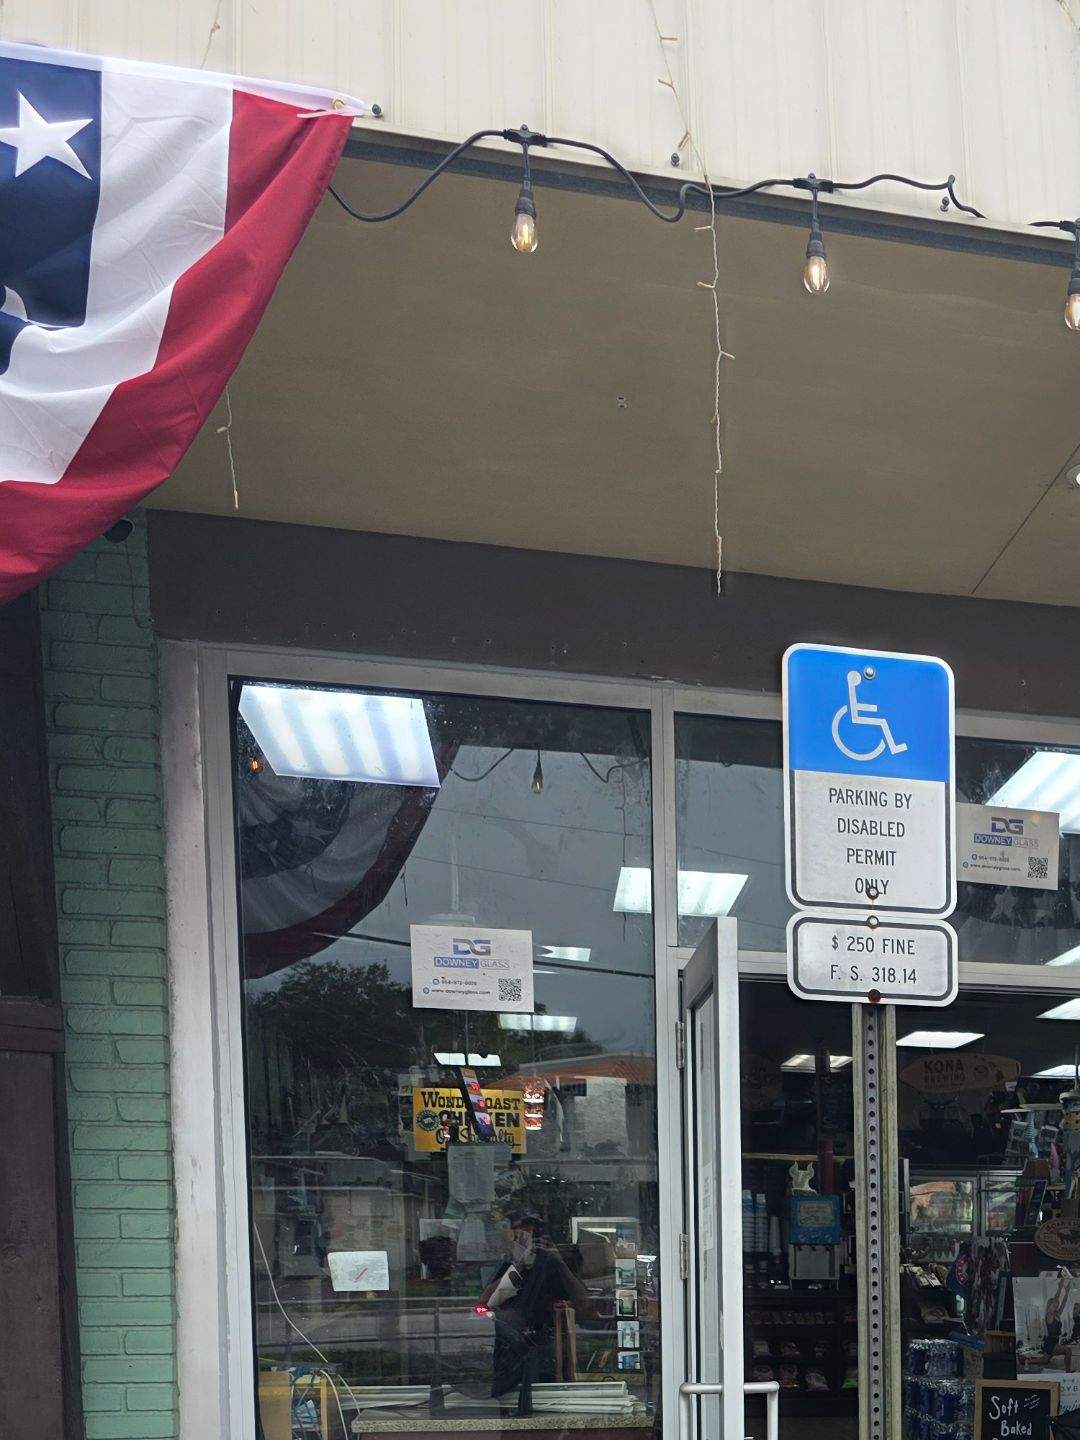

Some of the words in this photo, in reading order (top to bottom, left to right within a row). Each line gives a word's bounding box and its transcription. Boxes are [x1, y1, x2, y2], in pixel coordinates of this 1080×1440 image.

[829, 787, 888, 808] PARKING
[894, 792, 913, 809] BY
[837, 817, 905, 838] DISABLED
[991, 816, 1024, 835] DG
[974, 833, 1012, 846] DOWNEY
[846, 847, 897, 866] PERMIT
[855, 877, 890, 895] ONLY
[453, 938, 491, 956] DG
[831, 935, 839, 951] $
[846, 936, 875, 953] 250
[882, 938, 915, 955] FINE
[435, 957, 478, 969] DOWNEY
[830, 964, 841, 980] F.
[850, 965, 863, 982] S.
[871, 967, 917, 984] 318.14
[924, 1060, 964, 1073] KONA
[989, 1395, 1019, 1420] Soft
[1000, 1420, 1033, 1437] Baked
